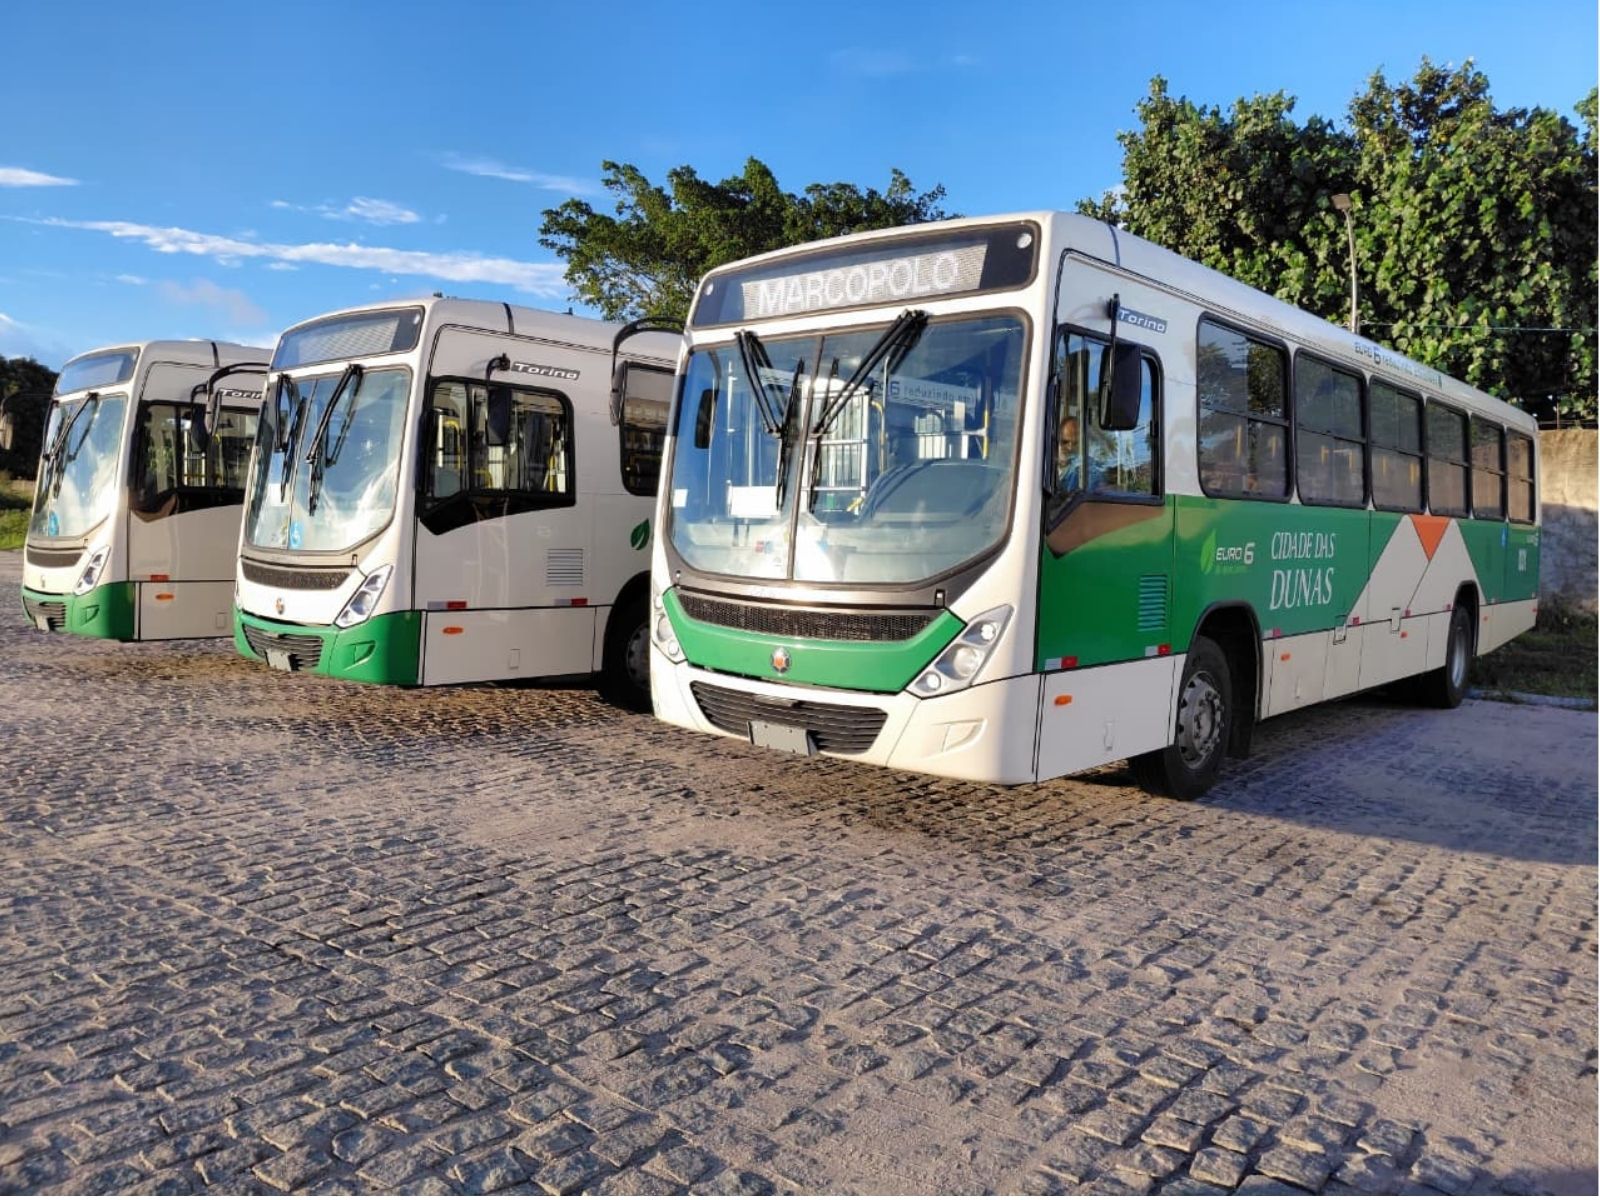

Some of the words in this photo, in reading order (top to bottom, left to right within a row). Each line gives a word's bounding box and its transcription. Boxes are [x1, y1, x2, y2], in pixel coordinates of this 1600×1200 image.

[757, 252, 959, 315] MARCOPOLO
[1119, 308, 1166, 333] Torino
[514, 362, 578, 380] Torino
[1215, 546, 1243, 561] EURO
[1243, 541, 1256, 565] 6
[1271, 532, 1314, 560] CIDADE
[1314, 532, 1336, 559] DAS
[1269, 566, 1335, 611] DUNAS
